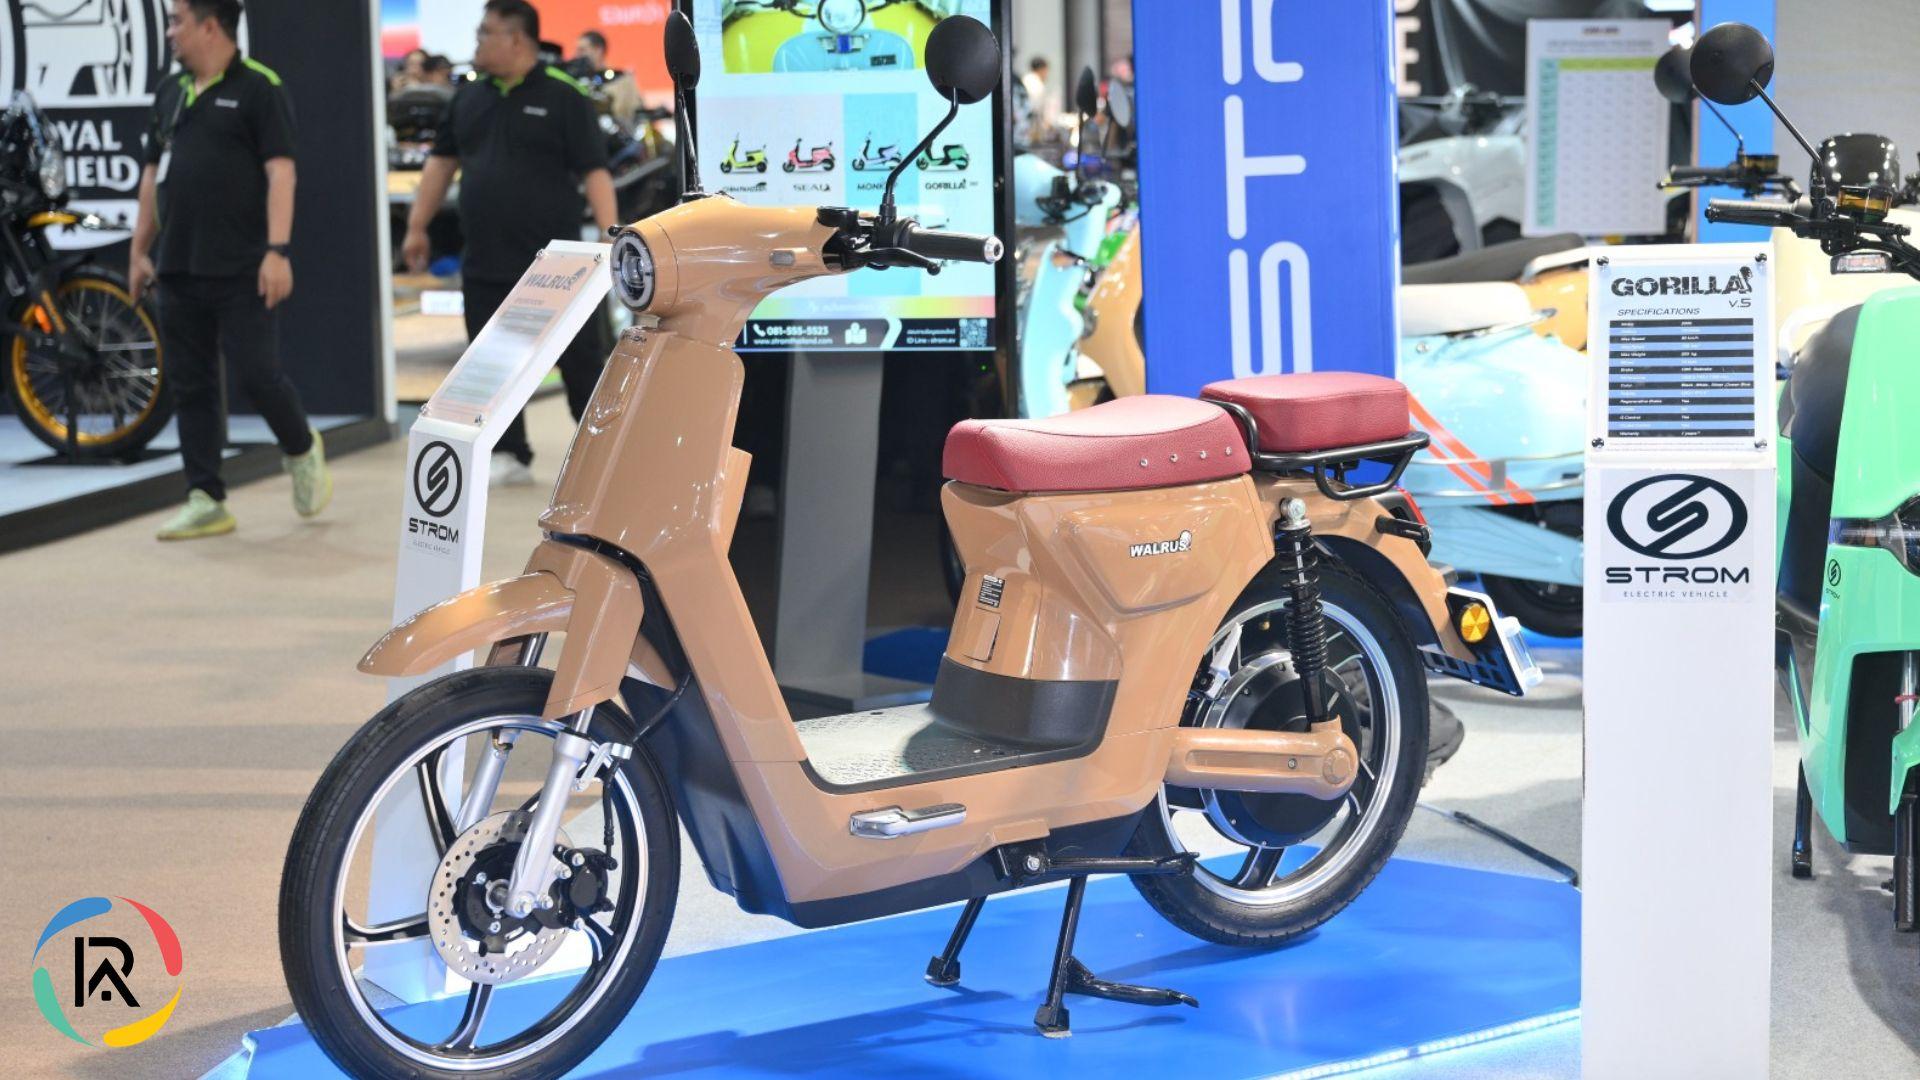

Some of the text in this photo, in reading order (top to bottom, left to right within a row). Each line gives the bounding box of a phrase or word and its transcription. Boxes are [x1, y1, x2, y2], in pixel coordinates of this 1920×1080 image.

[524, 274, 573, 291] WALRUS
[1611, 274, 1750, 297] GORILLA
[1617, 308, 1700, 317] SPECIFICATIONS
[408, 517, 459, 543] STROM
[1130, 540, 1188, 558] WALRUS
[1605, 567, 1749, 584] STROM
[1623, 590, 1728, 598] ELECTRIC VEHICLE
